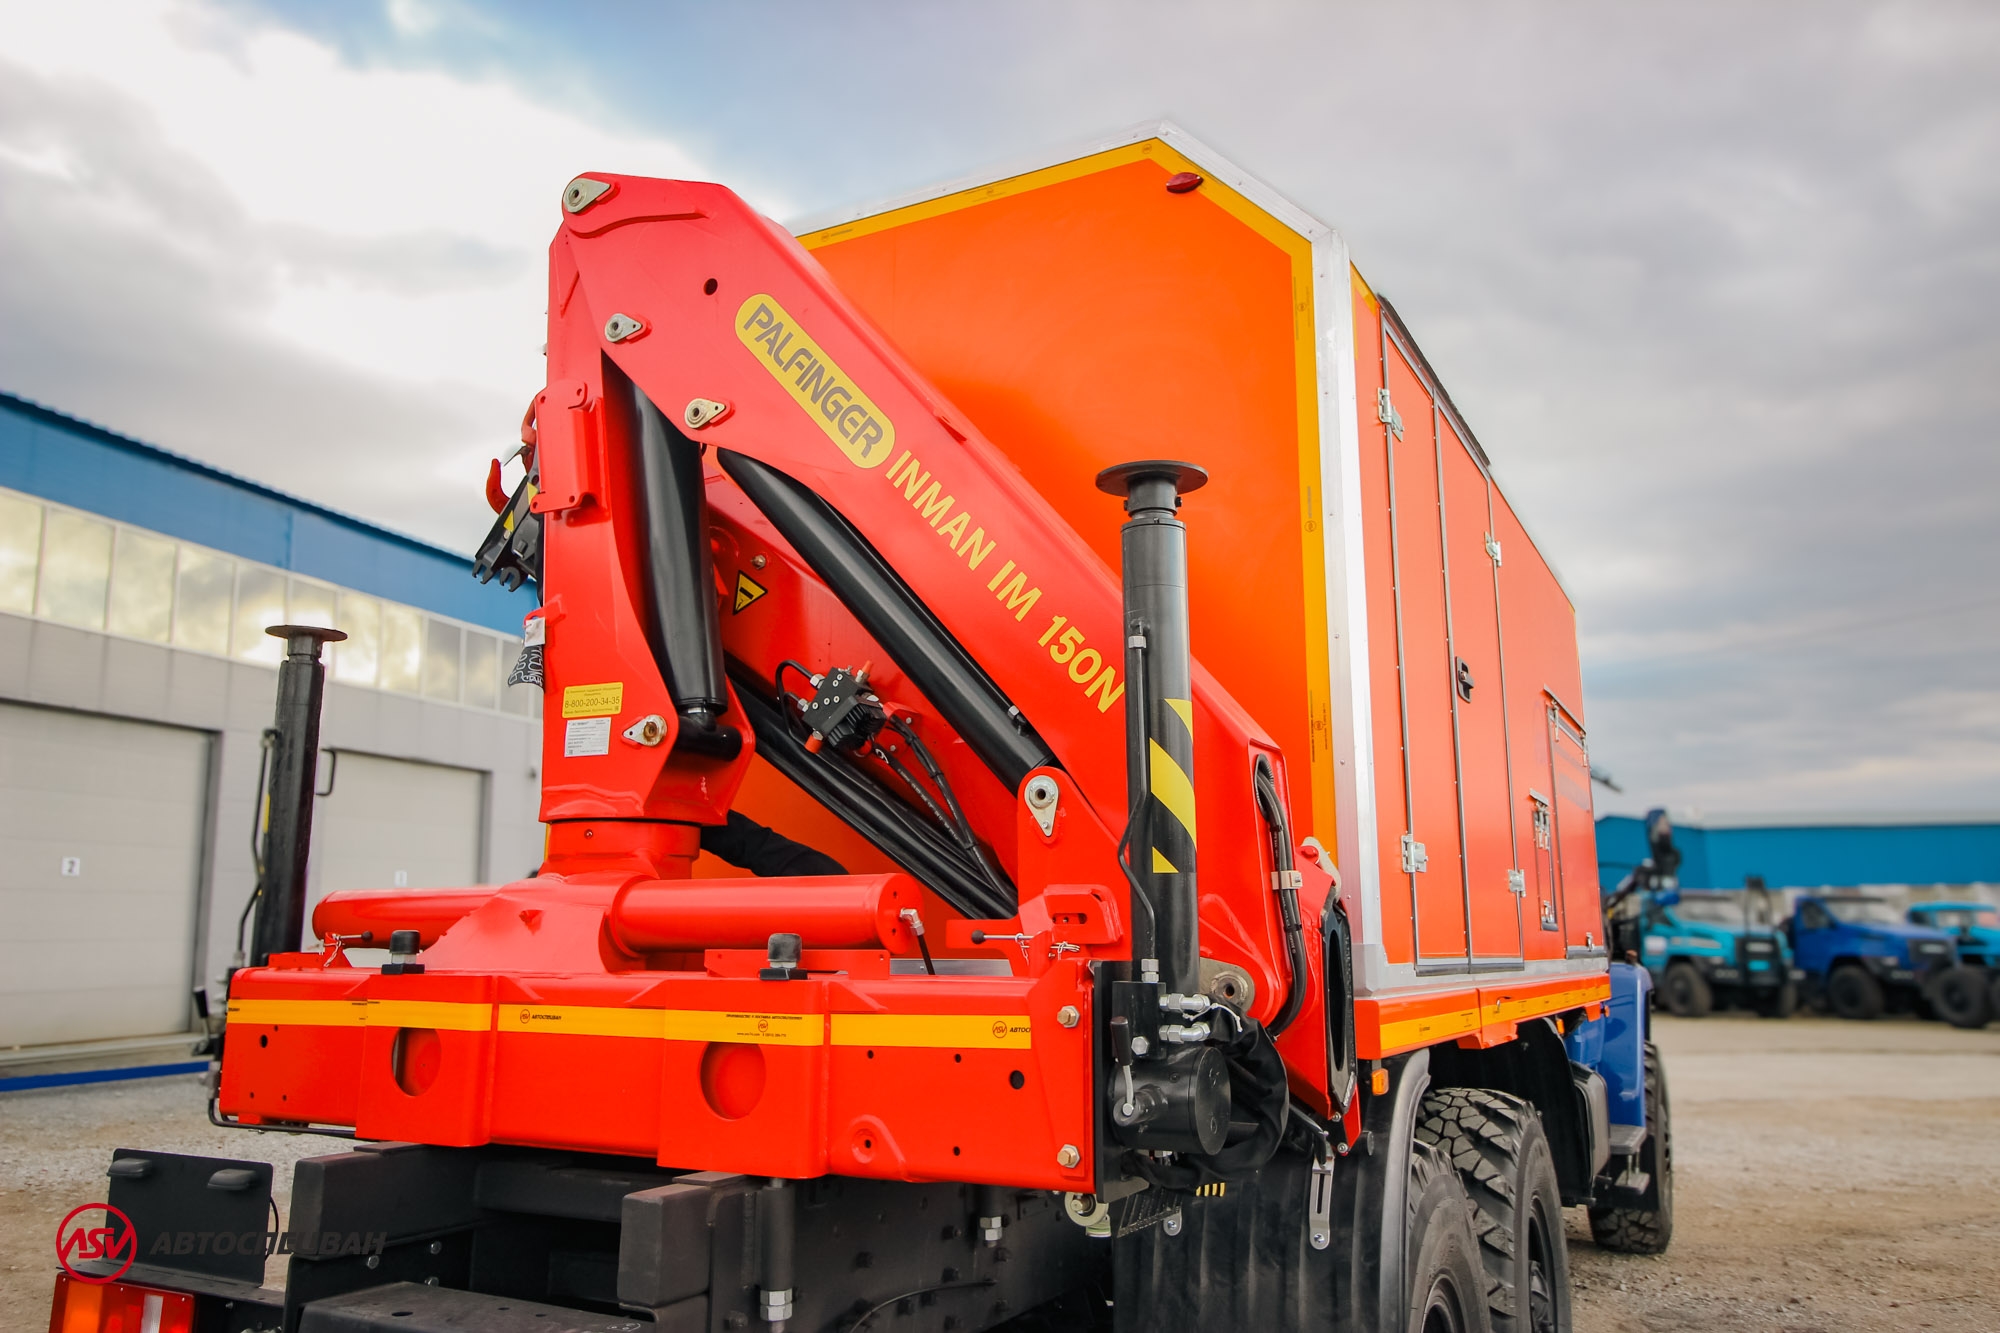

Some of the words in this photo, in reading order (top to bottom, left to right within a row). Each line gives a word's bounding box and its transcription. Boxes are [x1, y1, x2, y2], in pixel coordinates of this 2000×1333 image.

[743, 303, 883, 458] PALFINGER
[885, 450, 997, 571] INMAN
[987, 560, 1042, 622] IM
[1037, 615, 1125, 713] 150N
[564, 696, 620, 709] 8-800-200-34-35
